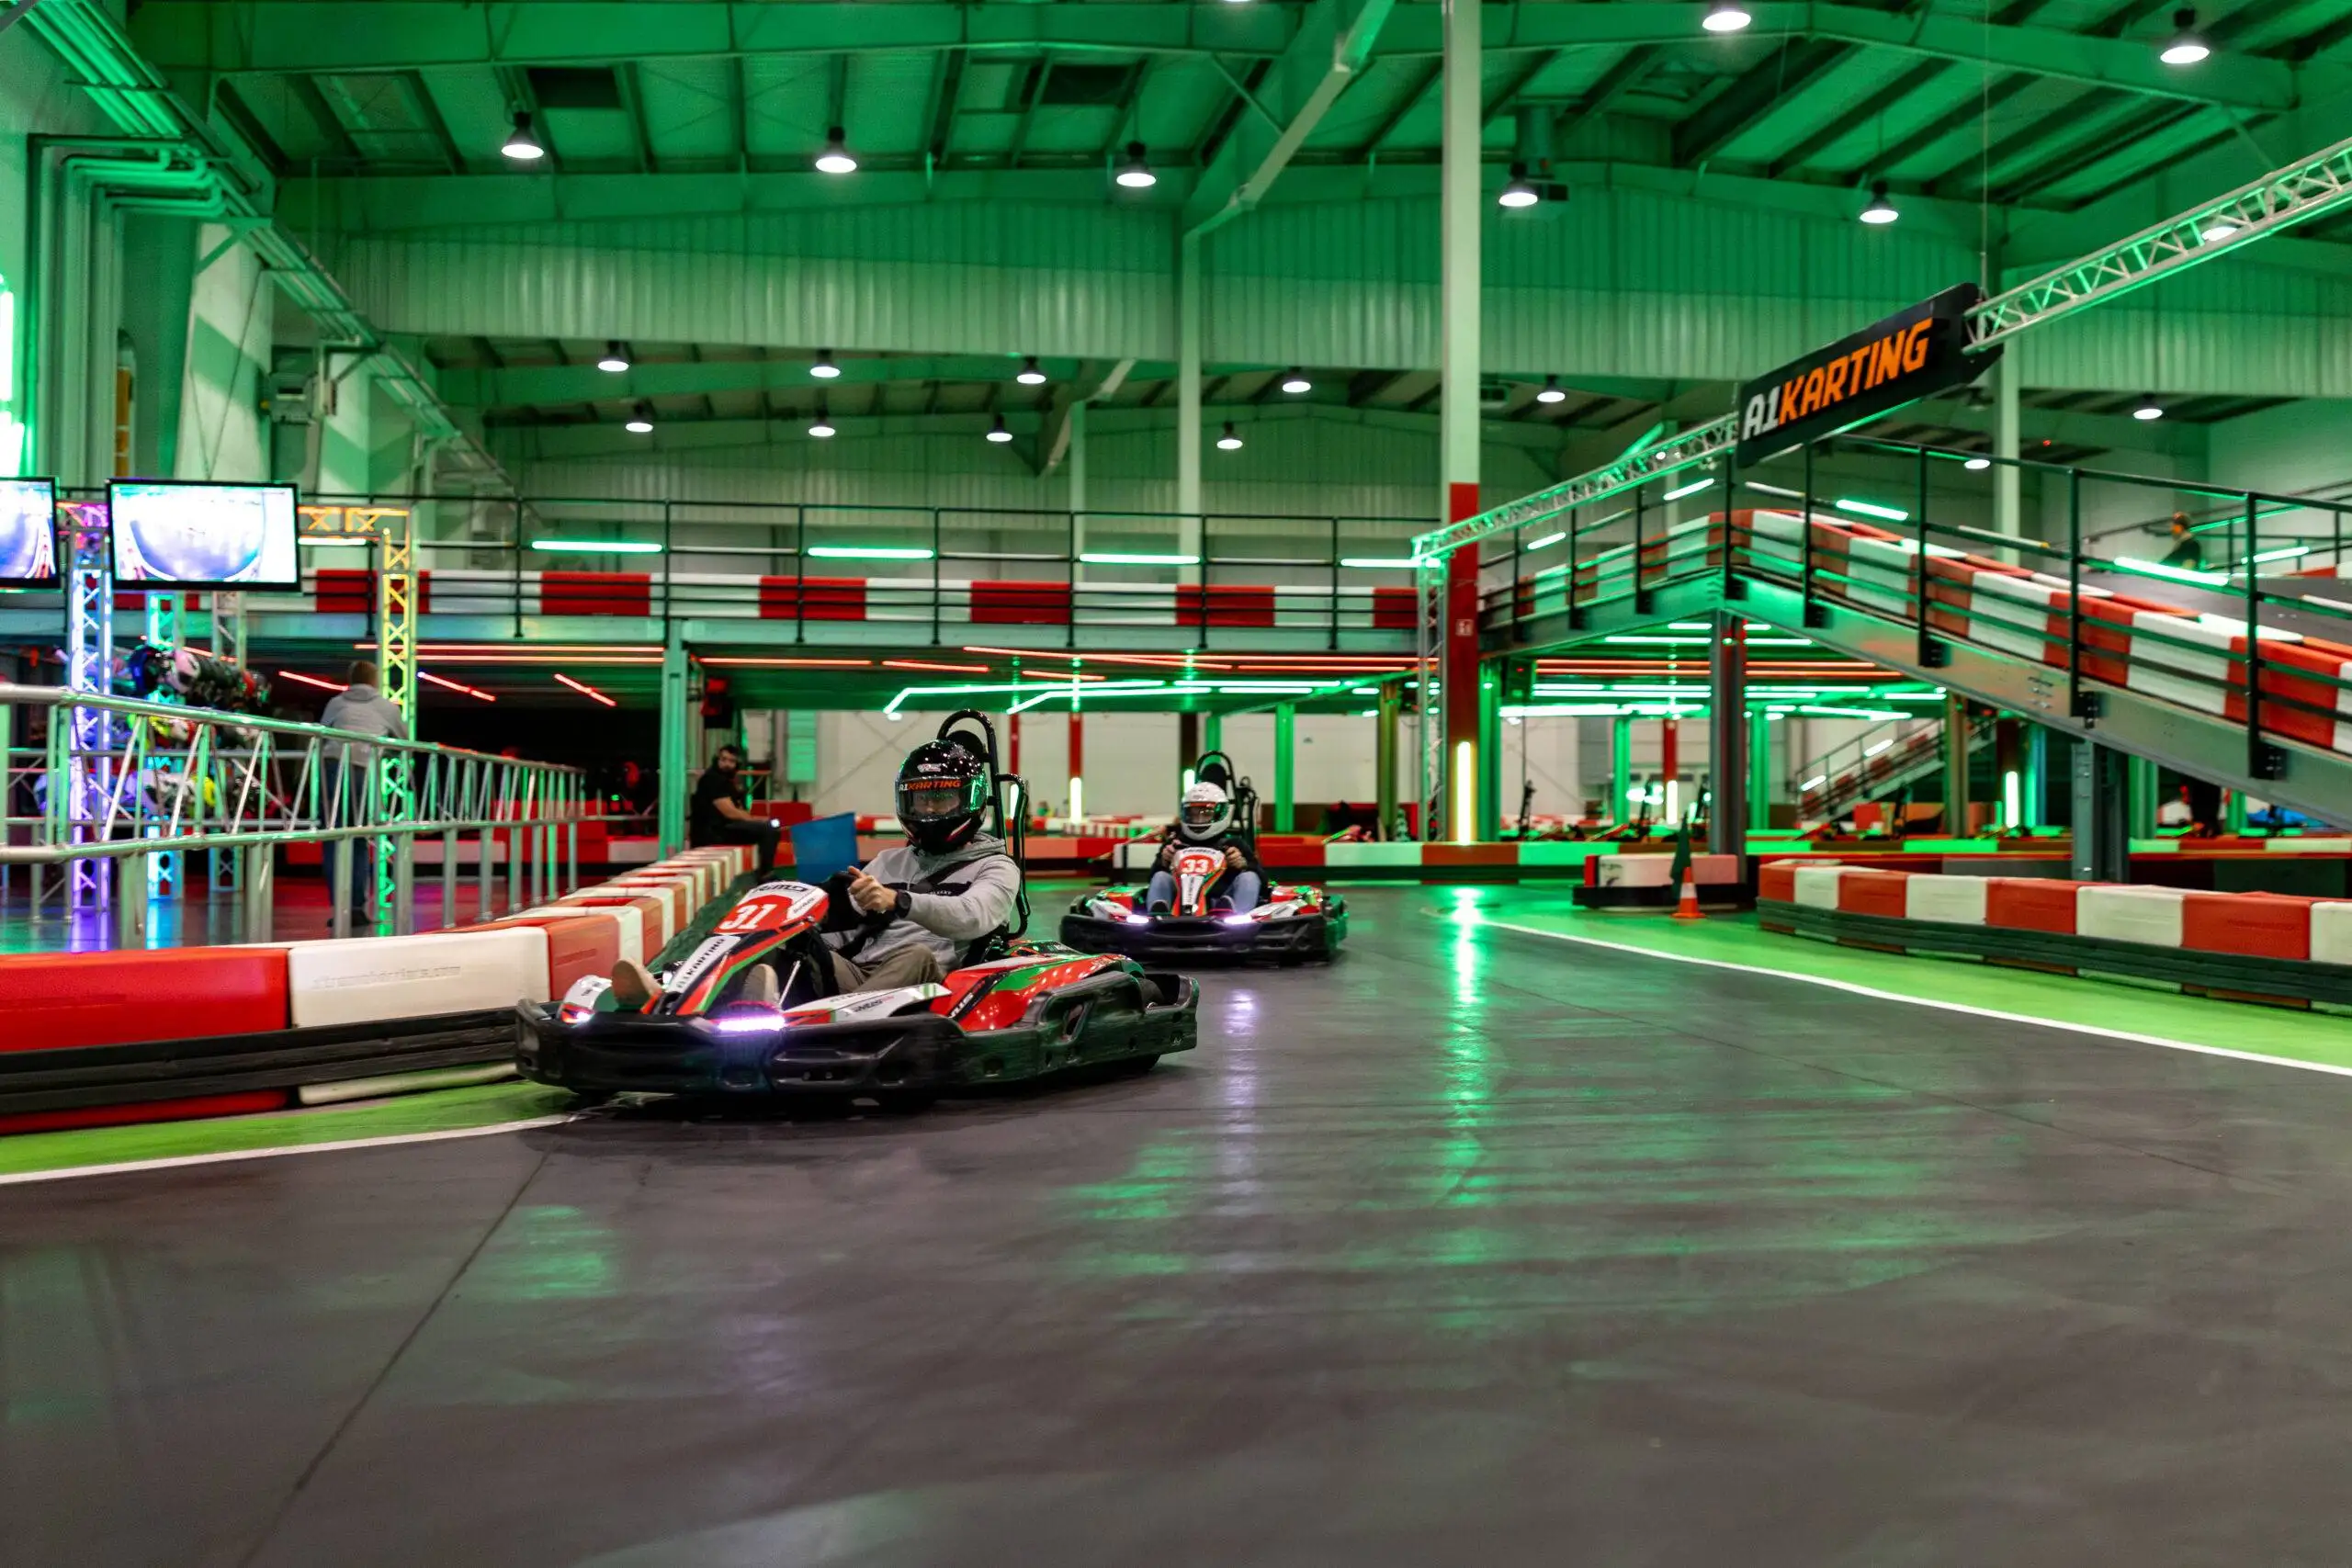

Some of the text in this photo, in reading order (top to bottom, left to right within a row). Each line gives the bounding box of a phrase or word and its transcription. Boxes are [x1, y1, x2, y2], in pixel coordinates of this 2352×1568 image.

[1743, 317, 1932, 441] A1KARTING
[1182, 859, 1208, 873] 33
[719, 904, 777, 930] 31
